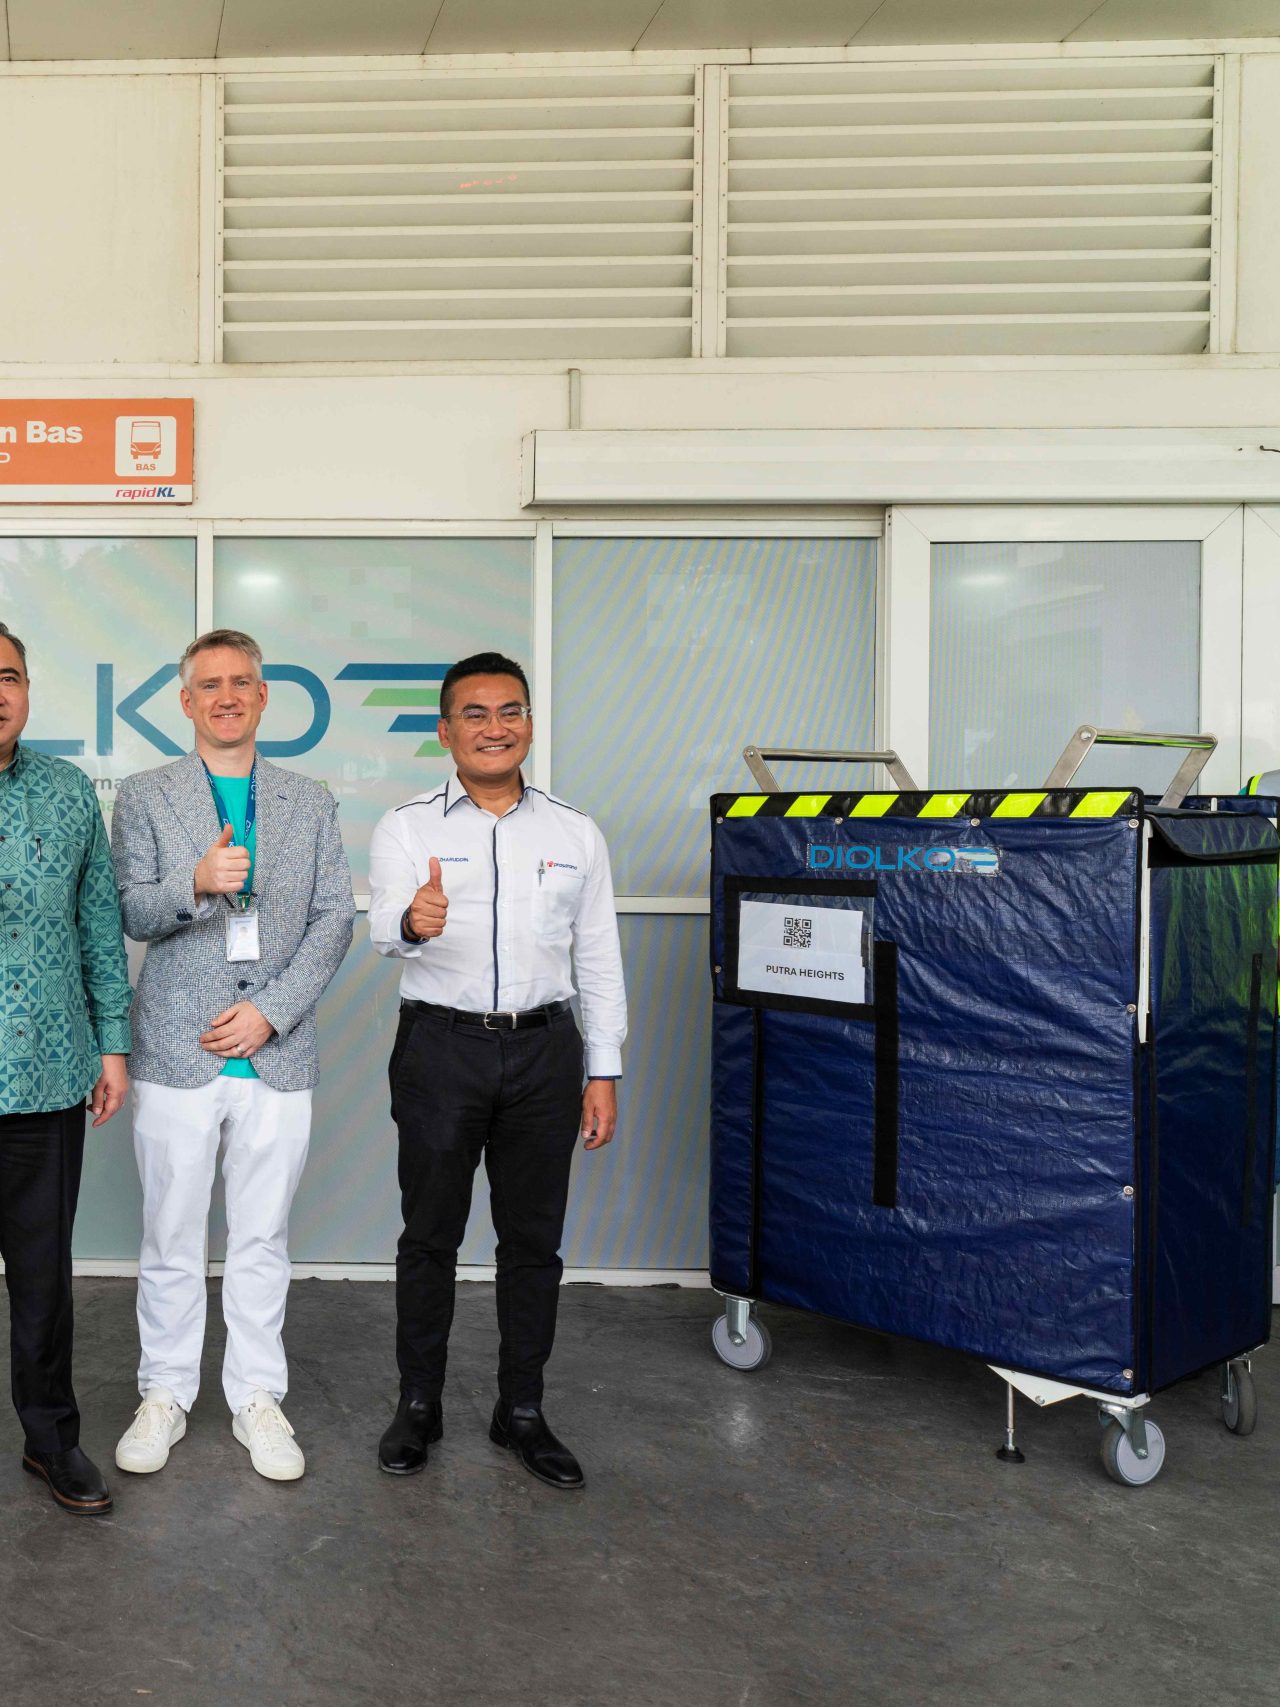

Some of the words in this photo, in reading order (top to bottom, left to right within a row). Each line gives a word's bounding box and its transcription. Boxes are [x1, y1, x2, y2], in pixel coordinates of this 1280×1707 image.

[26, 421, 83, 444] Bas
[136, 463, 156, 471] BAS
[115, 487, 176, 499] rapidKL
[810, 845, 956, 871] DIOLKO
[766, 965, 797, 976] PUTRA
[799, 969, 845, 981] HEIGHTS
